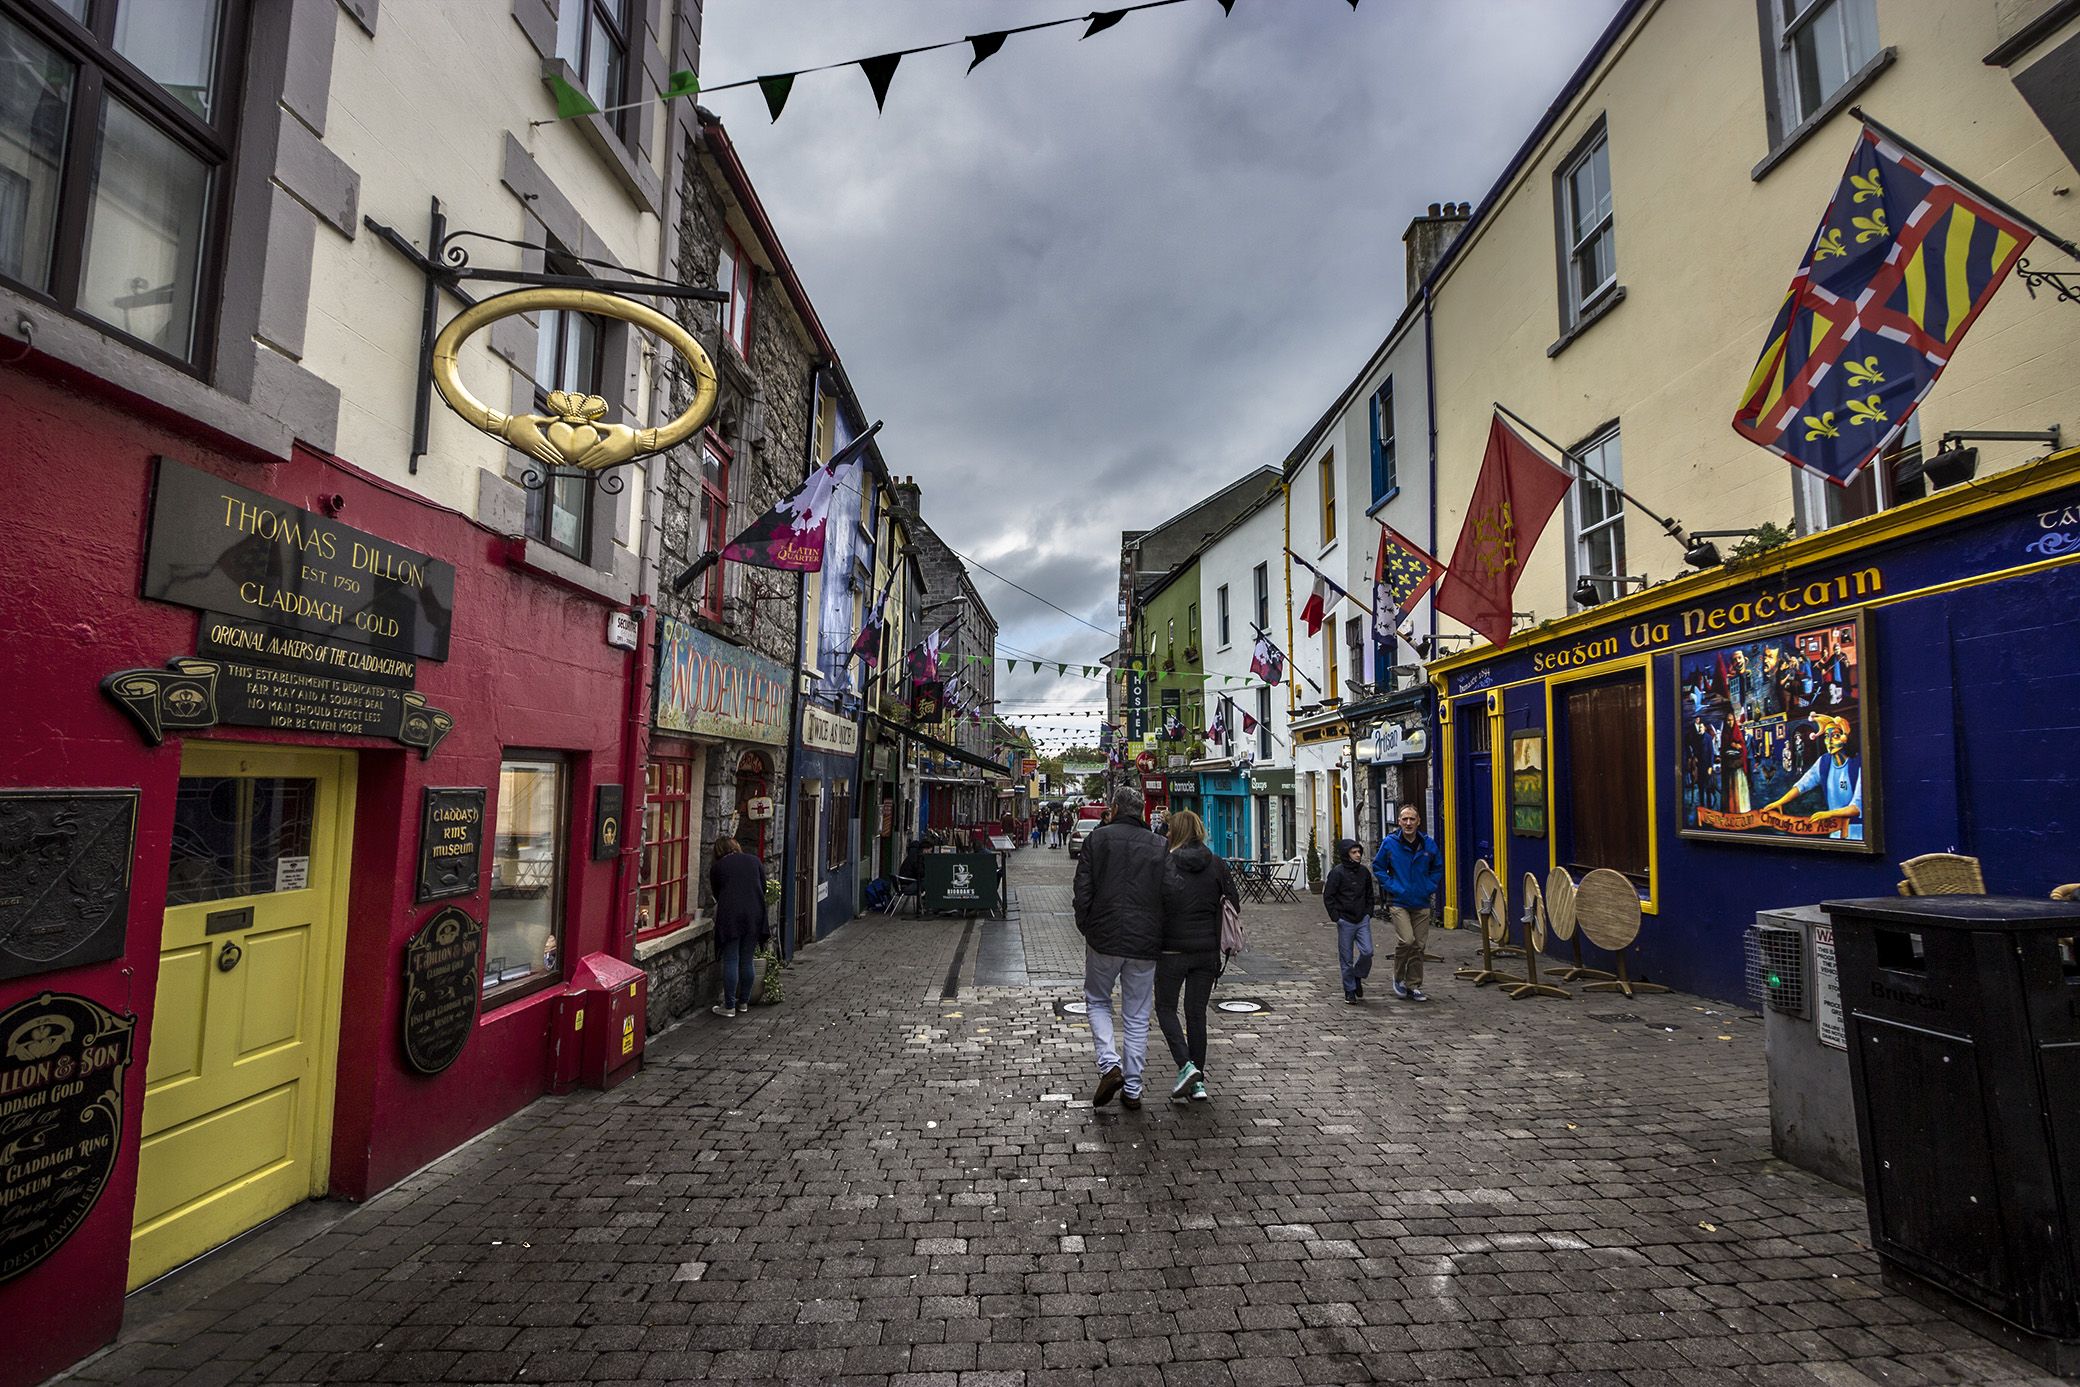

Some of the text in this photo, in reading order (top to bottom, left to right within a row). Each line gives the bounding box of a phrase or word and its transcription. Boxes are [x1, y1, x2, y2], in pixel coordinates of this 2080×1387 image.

[221, 495, 424, 589] THOMAS DILLON
[777, 549, 819, 562] QUARTER
[788, 542, 820, 556] LATIN
[301, 565, 360, 594] EST. 1750
[355, 611, 399, 637] GOLD
[1630, 622, 1670, 649] Ua
[211, 624, 414, 678] ORIGINAL MAKERS OF THE CLADDAGH RING
[228, 664, 252, 679] THIS
[255, 669, 330, 690] ESTABLISHMENT
[332, 680, 340, 691] IS
[342, 681, 385, 698] DEDICATED
[670, 639, 786, 728] WOODEN HEART
[246, 683, 384, 710] FAIR PLAY AND A SQUARE DEAL
[247, 698, 381, 723] NO MAN SHOULD EXPECT LESS
[1133, 675, 1142, 738] HOSTEL
[271, 715, 363, 734] NOR BE GIVEN MORE
[808, 714, 852, 747] TWICE AS NICE
[1375, 729, 1398, 761] Artisan
[1174, 780, 1195, 793] barnacles
[1760, 811, 1794, 832] Through
[1795, 820, 1812, 833] The
[1816, 818, 1838, 833] Ages
[423, 946, 450, 969] DILLON
[462, 940, 478, 956] SON
[54, 1055, 74, 1079] &
[80, 1043, 119, 1077] SON
[51, 1080, 84, 1103] GOLD
[6, 1134, 109, 1183] CLADDAGH RING
[44, 1177, 100, 1250] JEWELLERS
